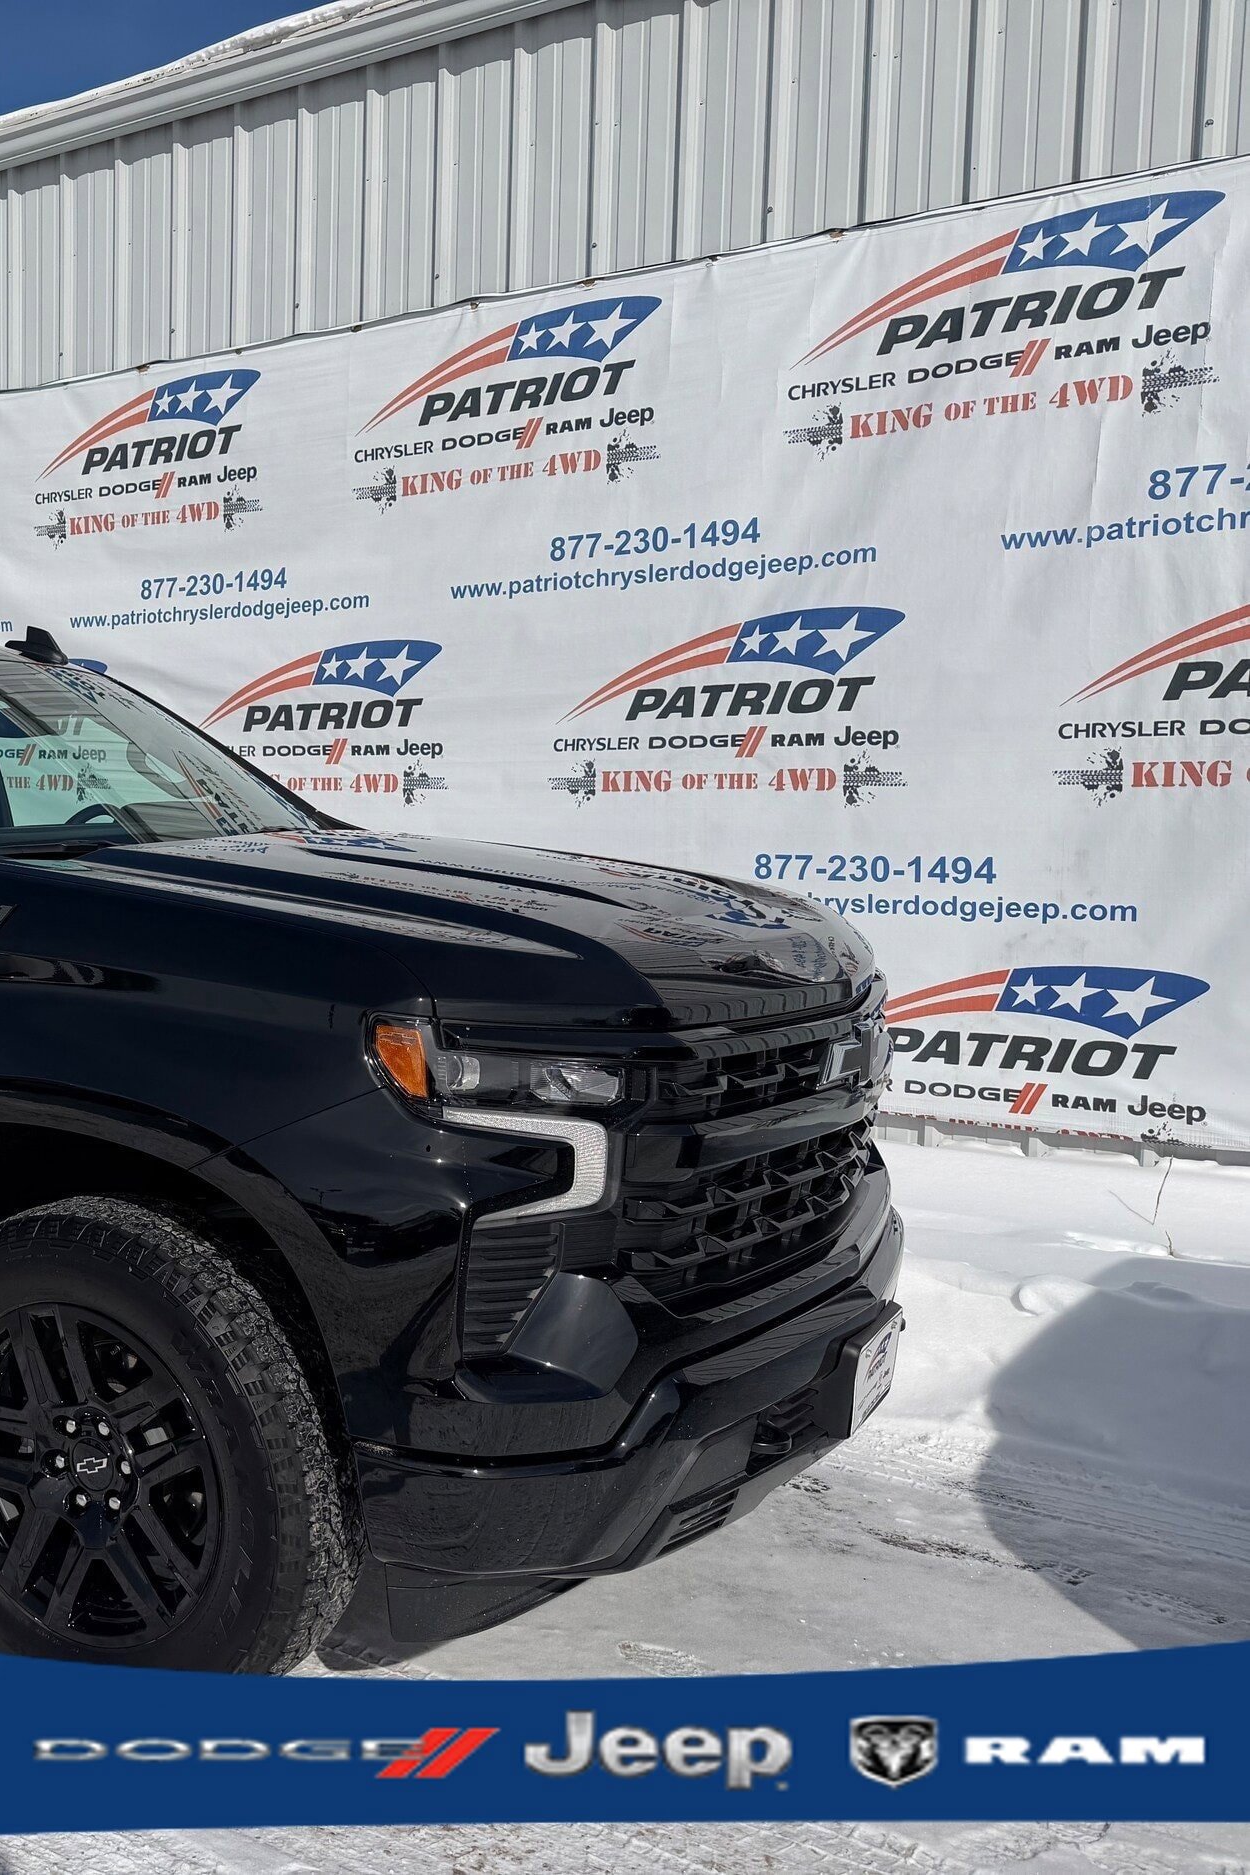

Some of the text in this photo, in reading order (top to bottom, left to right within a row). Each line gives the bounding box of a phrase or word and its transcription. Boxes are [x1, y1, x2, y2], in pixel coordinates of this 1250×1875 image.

[876, 266, 1186, 356] PATRIOT
[788, 320, 1211, 401] CHRYSLER DODGE RAM Jeep
[418, 359, 636, 426] PATRIOT
[850, 374, 1134, 439] KING OF THE 4WD
[81, 424, 242, 475] PATRIOT
[354, 406, 654, 463] CHRYSLER DODGE RAM Jeep
[35, 465, 257, 505] CHRYSLER DODGE RAM Jeep
[401, 449, 602, 497] KING OF THE 4WD
[1147, 463, 1250, 500] 877-
[70, 501, 220, 536] KING OF THE 4WD
[550, 517, 761, 561] 877-230-1494
[140, 567, 287, 600] 877-230-1494
[450, 545, 877, 600] www.patriotchryslerdodgejeep.com
[70, 593, 370, 630] www.patriotchryslerdodgejeep.com
[243, 698, 424, 732] PATRIOT
[625, 676, 876, 721] PATRIOT
[553, 725, 899, 753] CHRYSLER DODGE RAM Jeep
[1058, 719, 1186, 739] CHRYSLER
[38, 748, 68, 760] RAM
[73, 745, 107, 763] Jeep
[262, 744, 333, 757] DODGE
[351, 744, 390, 756] RAM
[397, 739, 443, 758] Jeep
[36, 774, 74, 791] 4WD
[287, 777, 307, 791] OF
[311, 776, 343, 791] THE
[349, 773, 399, 793] 4WD
[601, 768, 837, 793] KING OF THE 4WD
[1131, 760, 1232, 787] KING
[754, 853, 998, 884] 877-230-1494
[892, 1026, 1178, 1080] PATRIOT
[905, 1080, 1019, 1103] DODGE
[1052, 1093, 1117, 1113] RAM
[1128, 1095, 1207, 1126] Jeep
